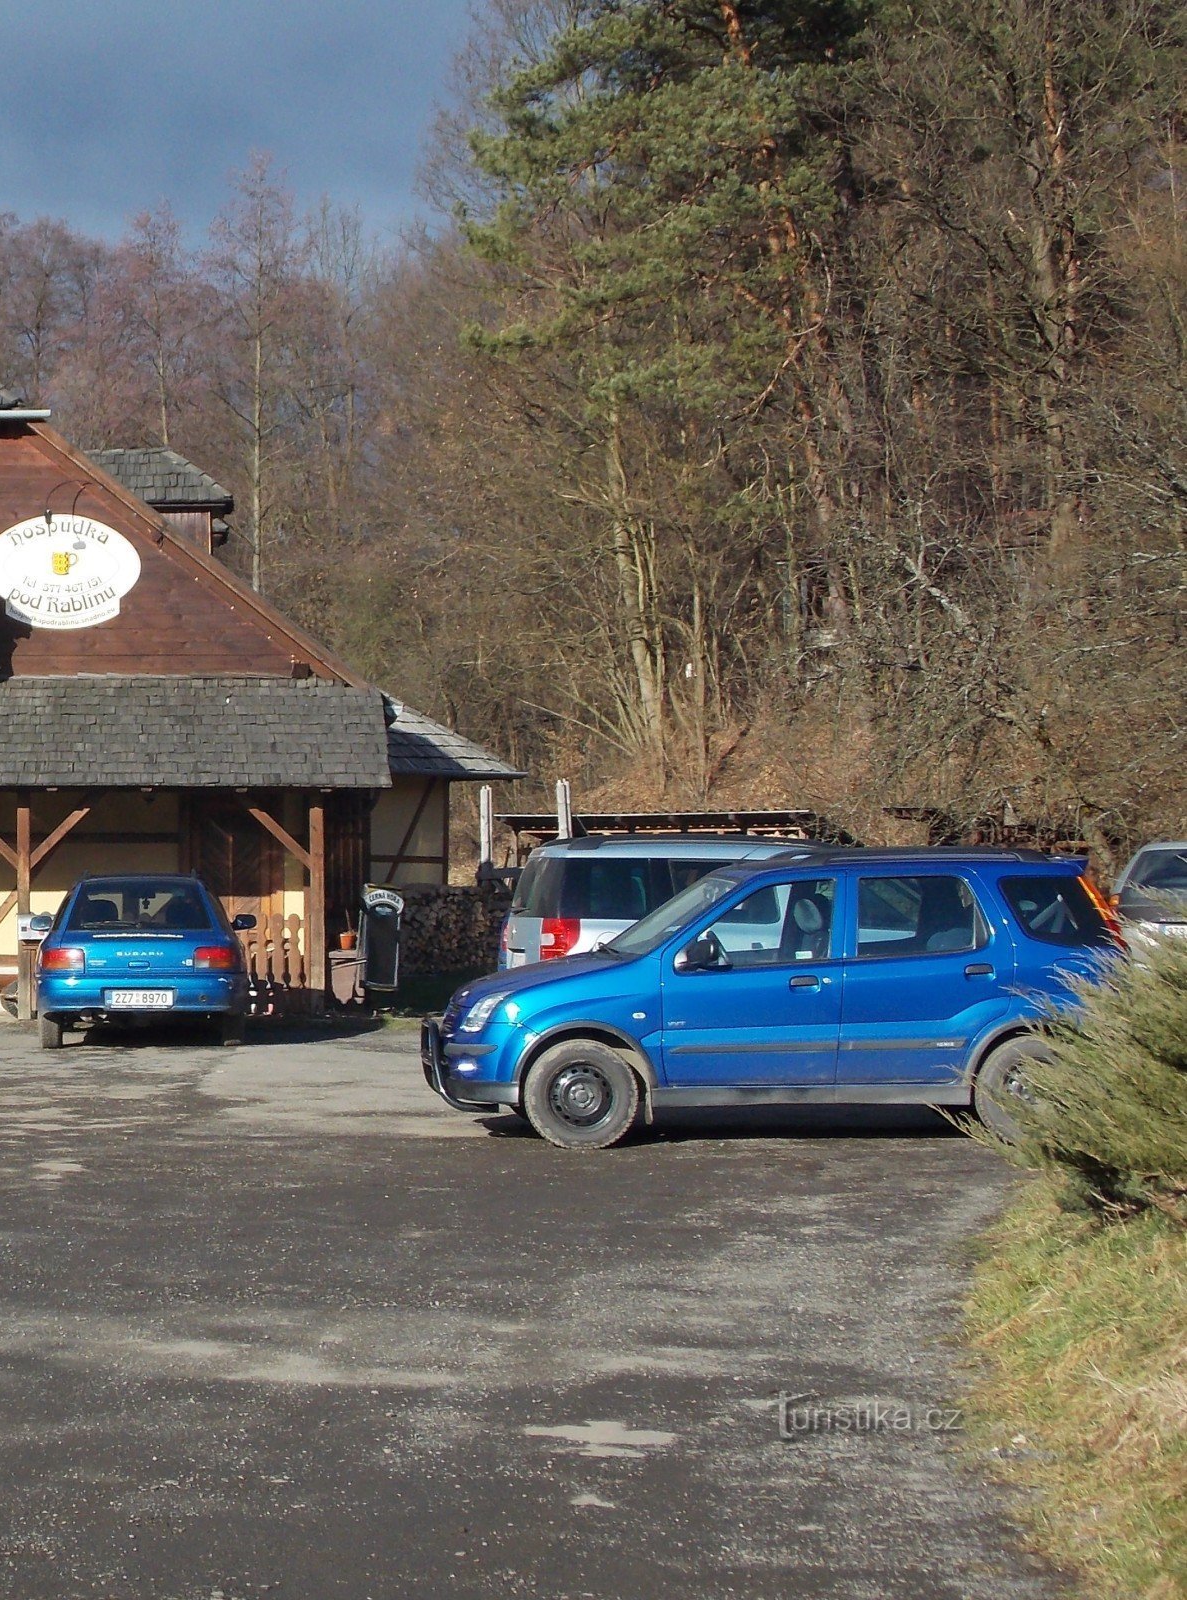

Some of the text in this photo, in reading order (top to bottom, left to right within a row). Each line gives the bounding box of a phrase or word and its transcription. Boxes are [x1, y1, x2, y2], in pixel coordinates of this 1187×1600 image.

[42, 583, 61, 594] 577
[7, 588, 43, 610] pod
[114, 993, 168, 1004] 2Z7 8970
